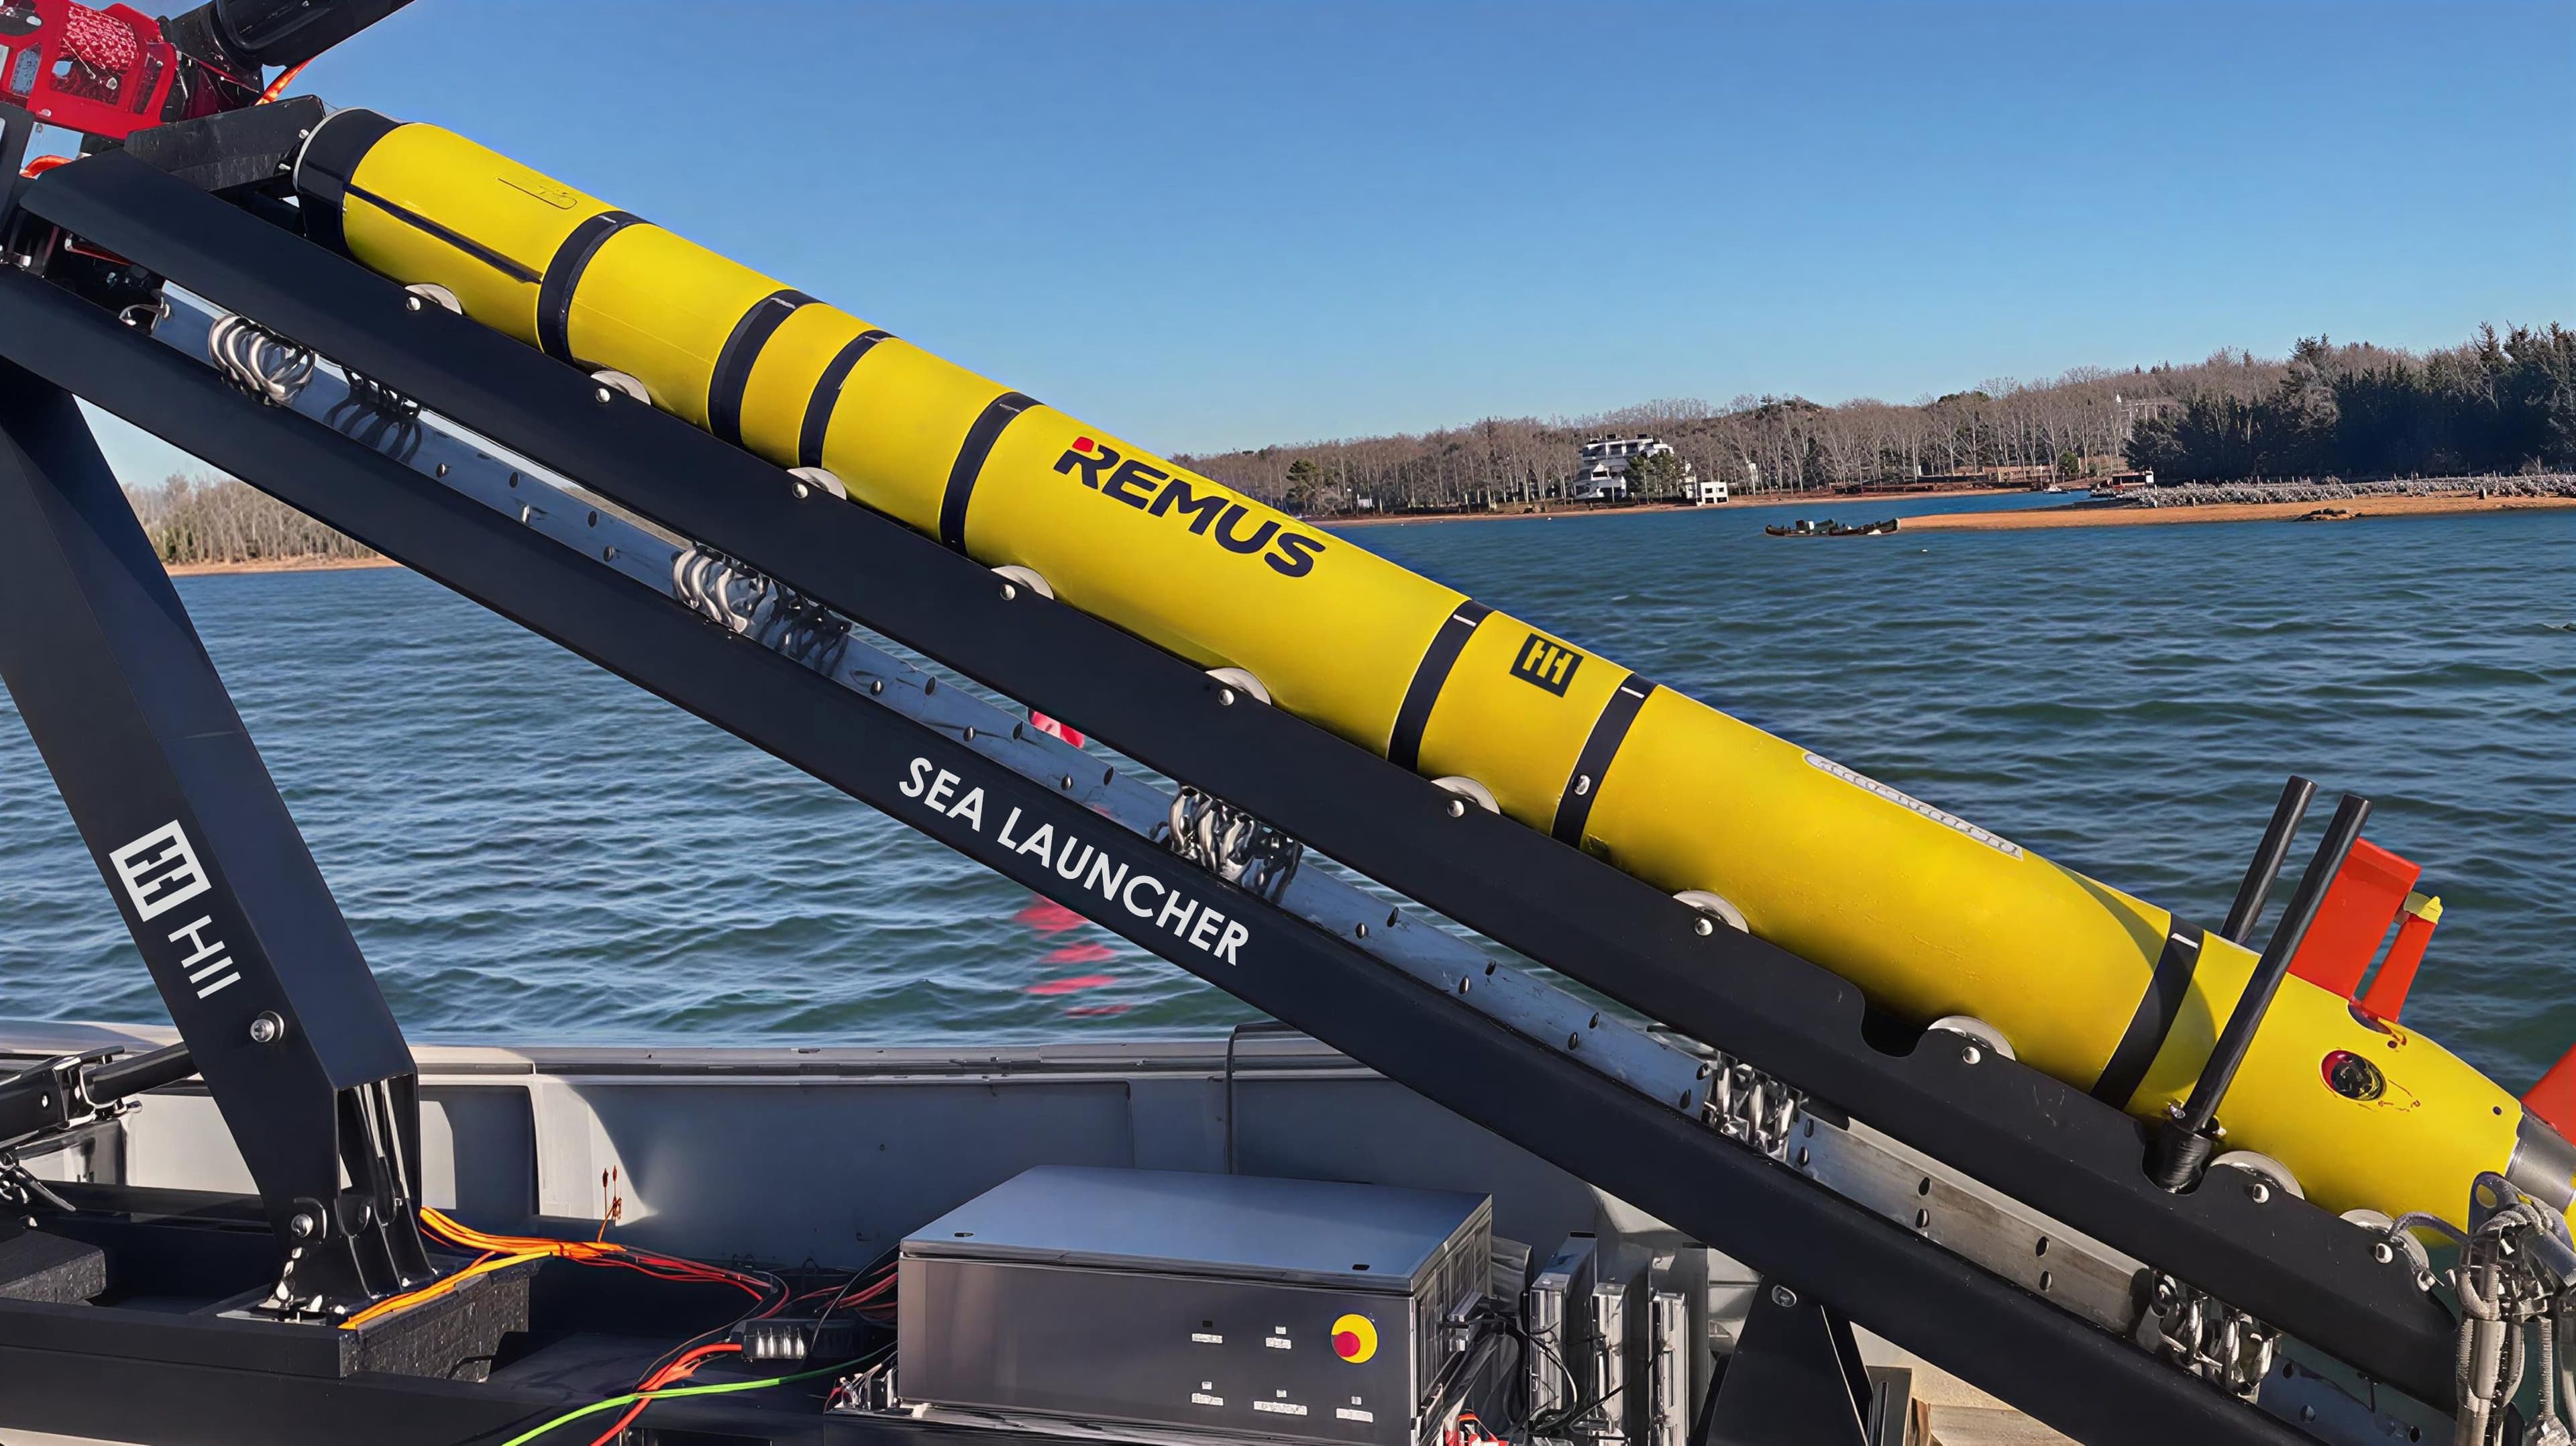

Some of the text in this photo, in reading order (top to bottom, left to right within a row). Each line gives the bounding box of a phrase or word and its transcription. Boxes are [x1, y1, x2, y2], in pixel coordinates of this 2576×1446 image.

[1053, 436, 1326, 578] REMUS
[899, 757, 1249, 966] SEA LAUNCHER
[168, 915, 241, 999] HII
